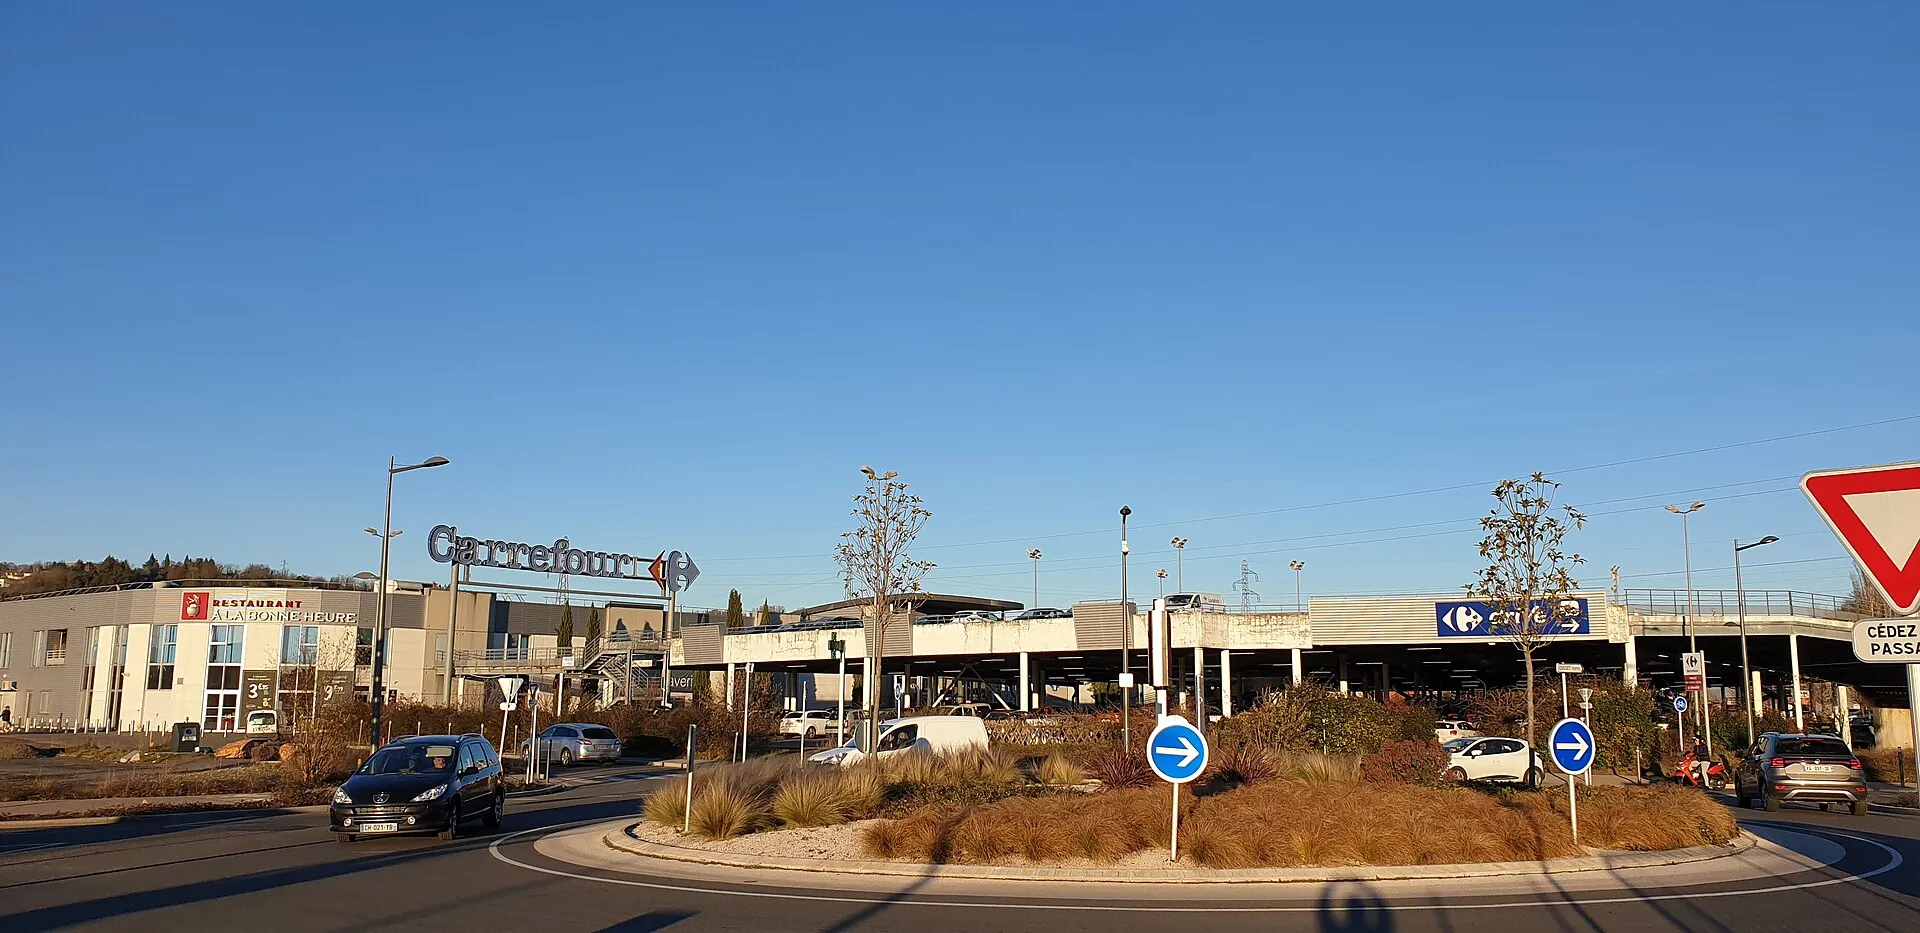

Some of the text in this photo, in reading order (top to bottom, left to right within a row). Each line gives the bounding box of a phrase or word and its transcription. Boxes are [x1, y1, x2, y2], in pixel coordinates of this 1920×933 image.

[428, 524, 631, 578] Carrefour
[212, 599, 303, 609] RESTAURANT
[225, 611, 245, 622] LA
[248, 611, 300, 622] BONNE
[303, 612, 357, 623] HEURE
[1867, 622, 1917, 639] CÉDEZ
